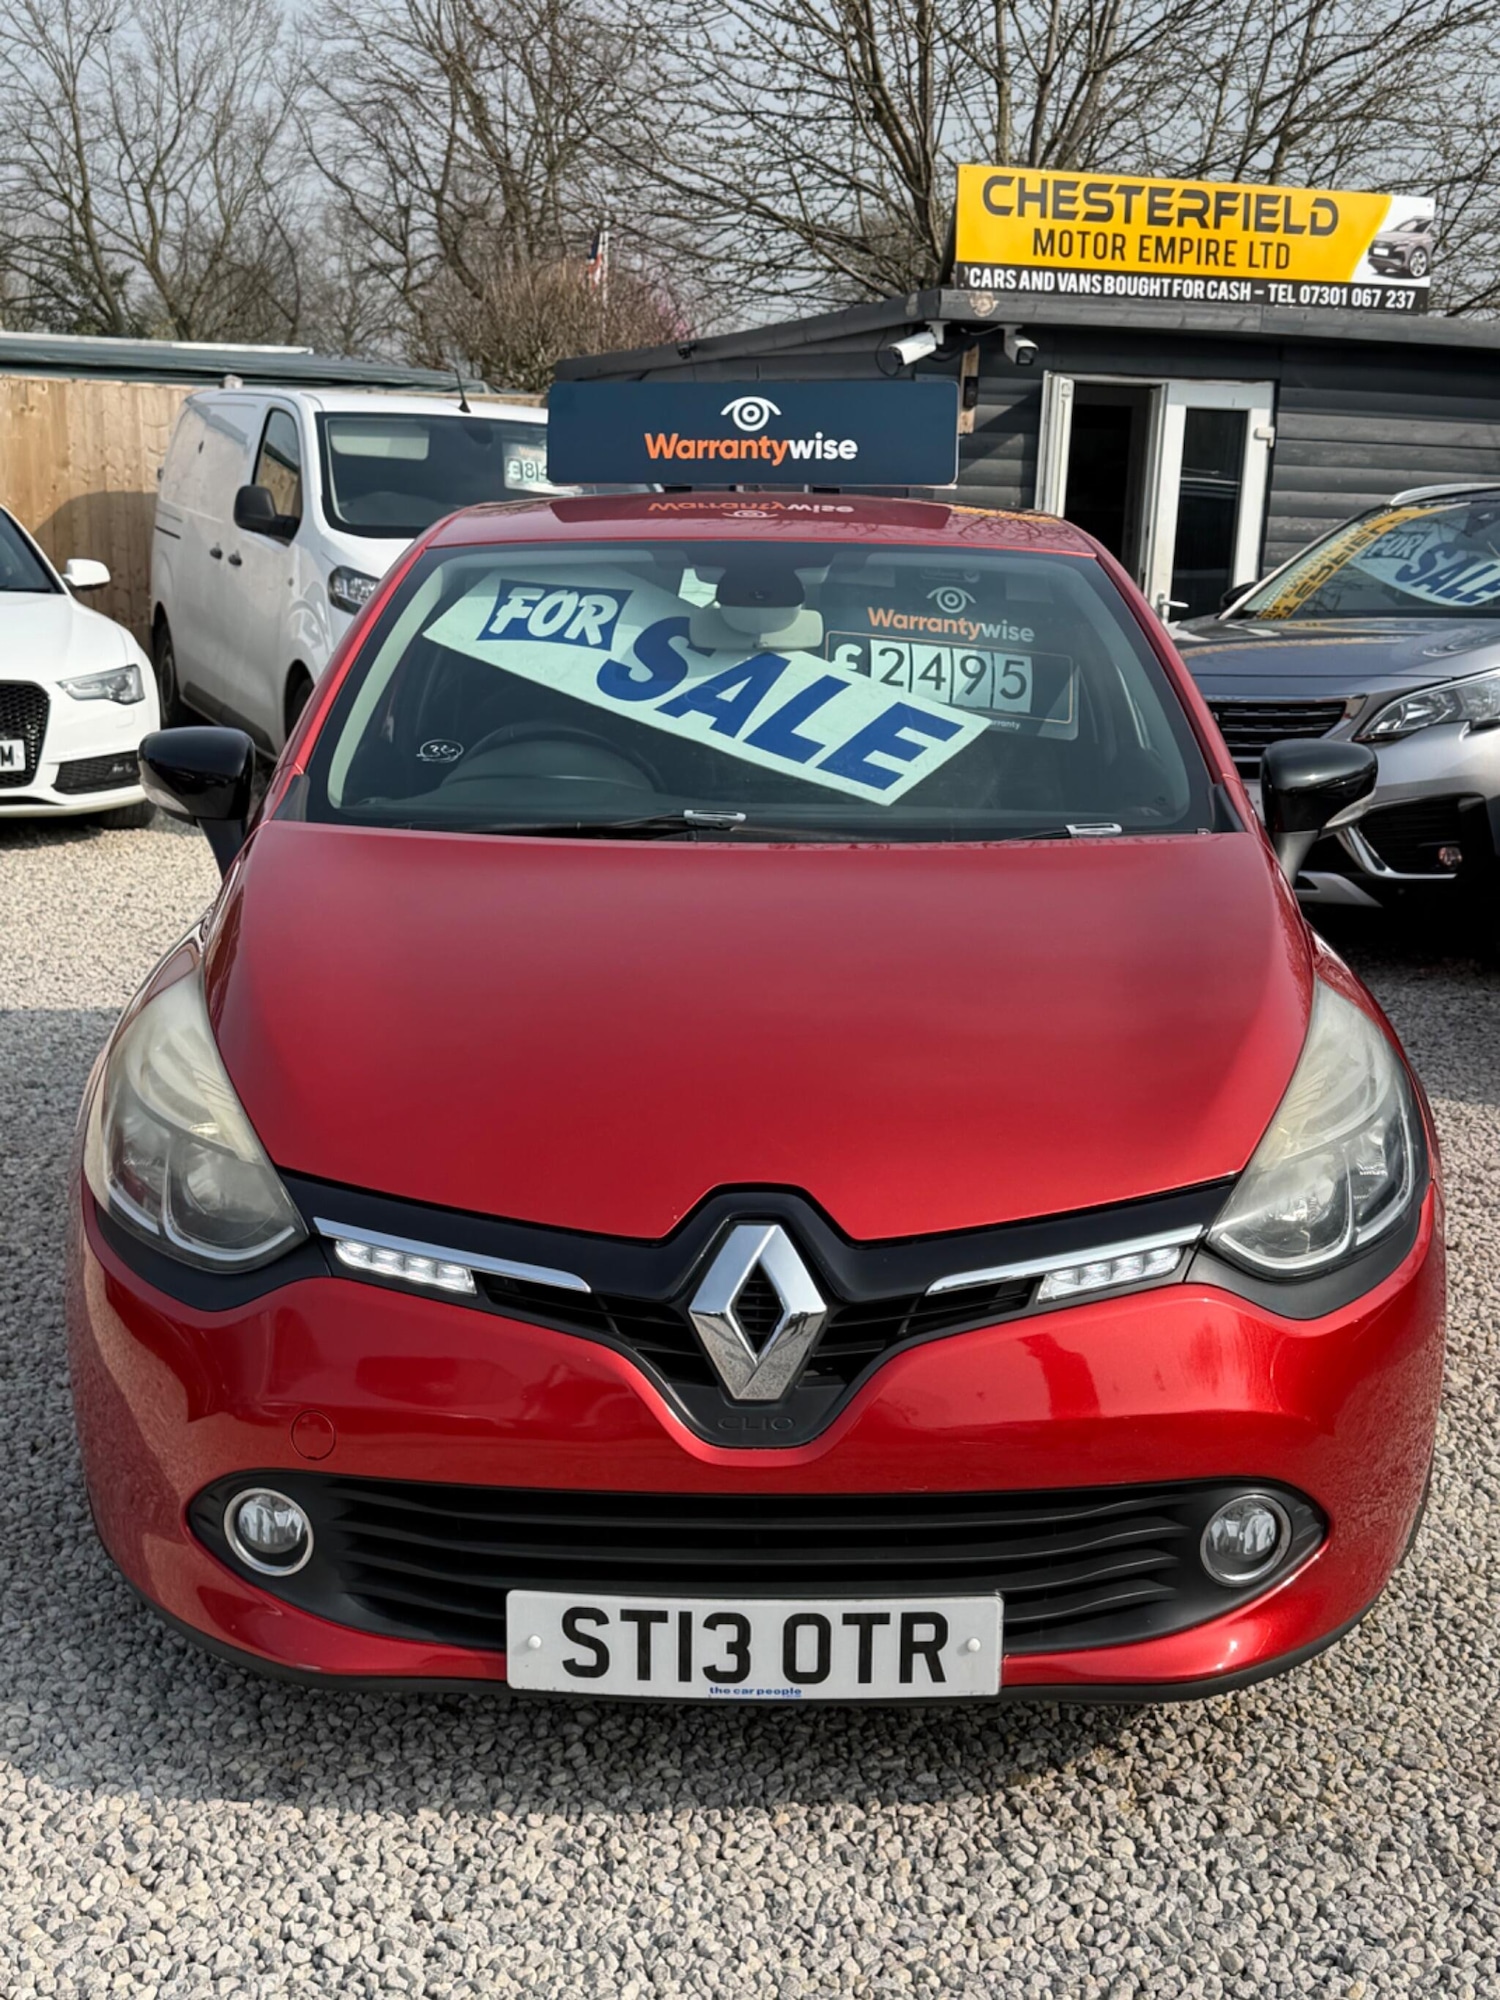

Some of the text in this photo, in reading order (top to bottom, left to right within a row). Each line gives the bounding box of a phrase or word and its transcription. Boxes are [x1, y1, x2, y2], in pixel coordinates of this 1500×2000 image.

[982, 175, 1339, 236] CHESTERFIELD
[1033, 228, 1290, 269] MOTOR EMPIRE LTD
[969, 267, 1017, 290] CARS
[1018, 270, 1055, 291] AND
[1057, 272, 1102, 294] VANS
[1104, 275, 1171, 298] BOUGHT
[1172, 278, 1206, 300] FOR
[1207, 280, 1251, 301] CASH
[1268, 284, 1296, 304] TEL
[1300, 286, 1347, 306] 07301
[1352, 288, 1380, 308] 067
[1384, 290, 1416, 309] 237
[644, 431, 858, 467] Warrantywise
[1366, 531, 1425, 558] FOR
[488, 586, 620, 647] FOR
[867, 606, 1035, 643] Warrantywise
[597, 617, 964, 790] SALE
[718, 1417, 793, 1431] CLIO
[562, 1606, 949, 1684] ST13 OTR
[709, 1686, 731, 1695] the
[756, 1687, 802, 1697] people
